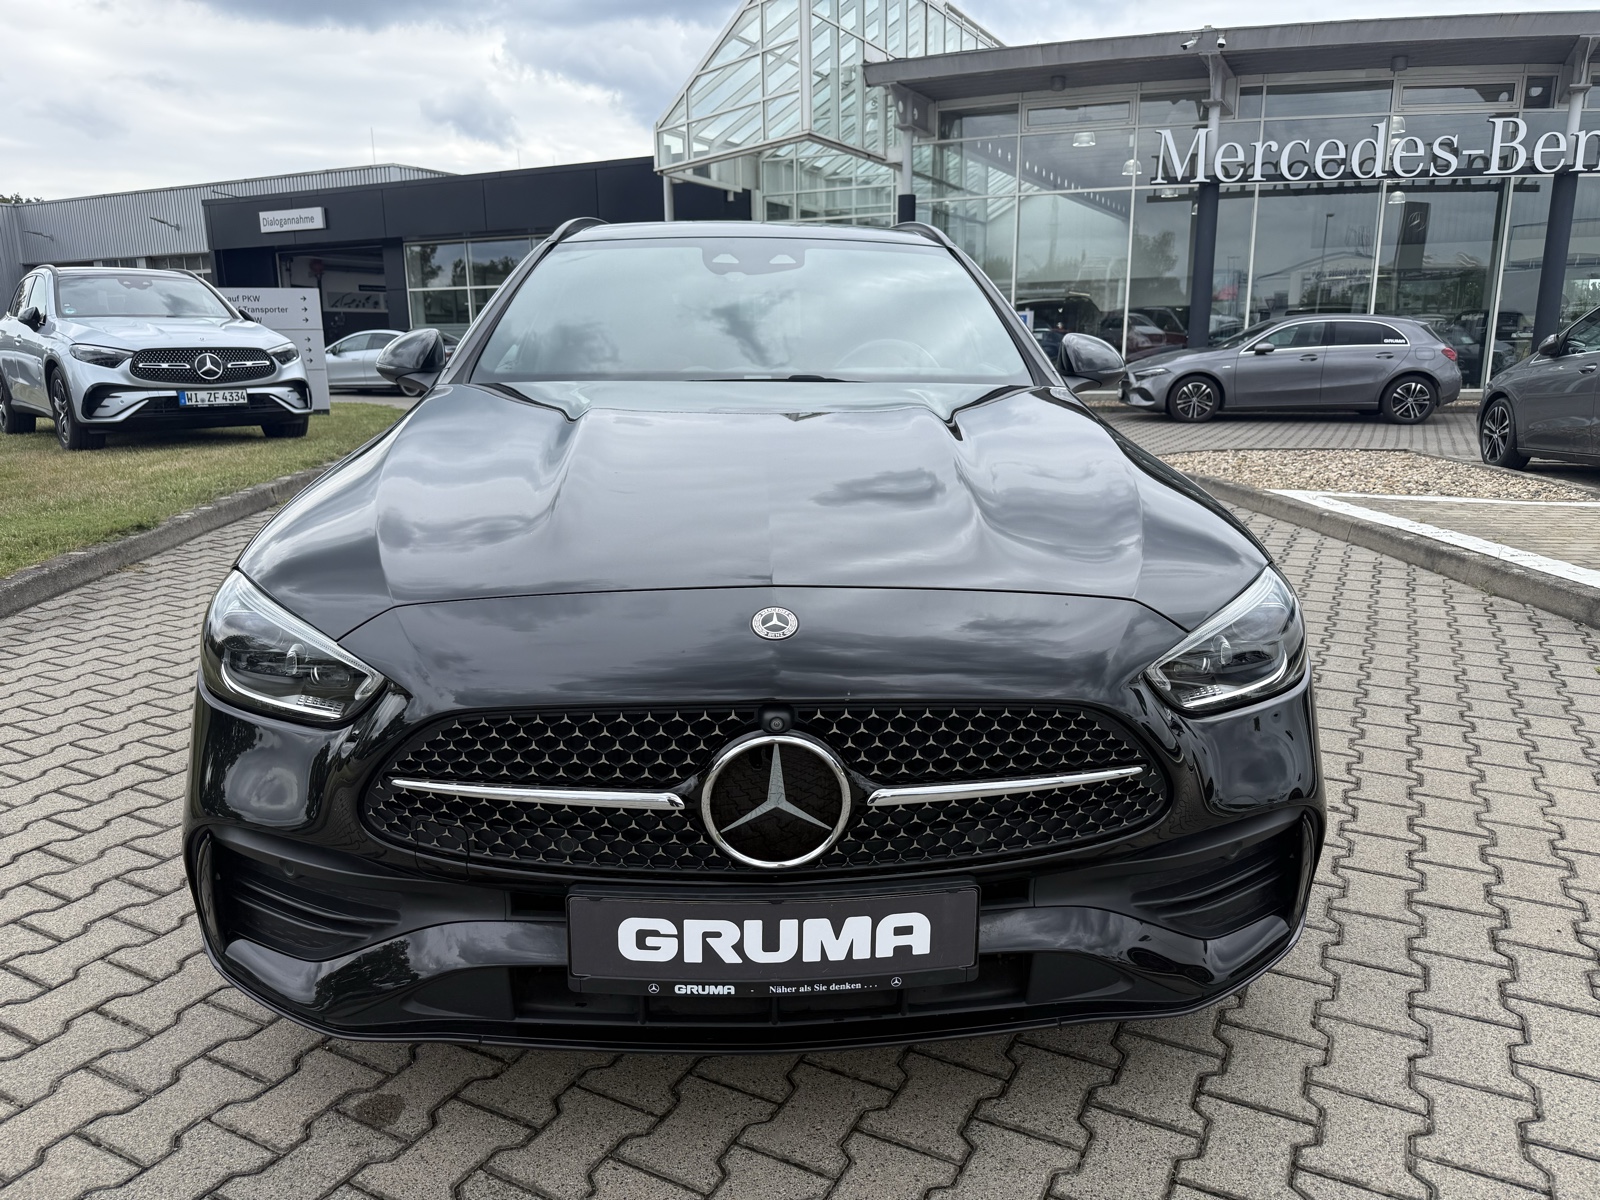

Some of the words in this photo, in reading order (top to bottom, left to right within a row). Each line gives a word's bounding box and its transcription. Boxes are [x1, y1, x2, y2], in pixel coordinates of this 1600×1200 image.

[262, 214, 315, 228] Dialogannahme
[225, 294, 240, 303] auf
[243, 305, 288, 315] Transporter
[207, 392, 219, 403] ZF
[222, 391, 246, 402] 4334
[617, 911, 931, 964] GRUMA
[674, 984, 735, 995] GRUMA
[769, 984, 797, 994] Näher
[799, 983, 811, 992] als
[813, 983, 828, 992] Sie
